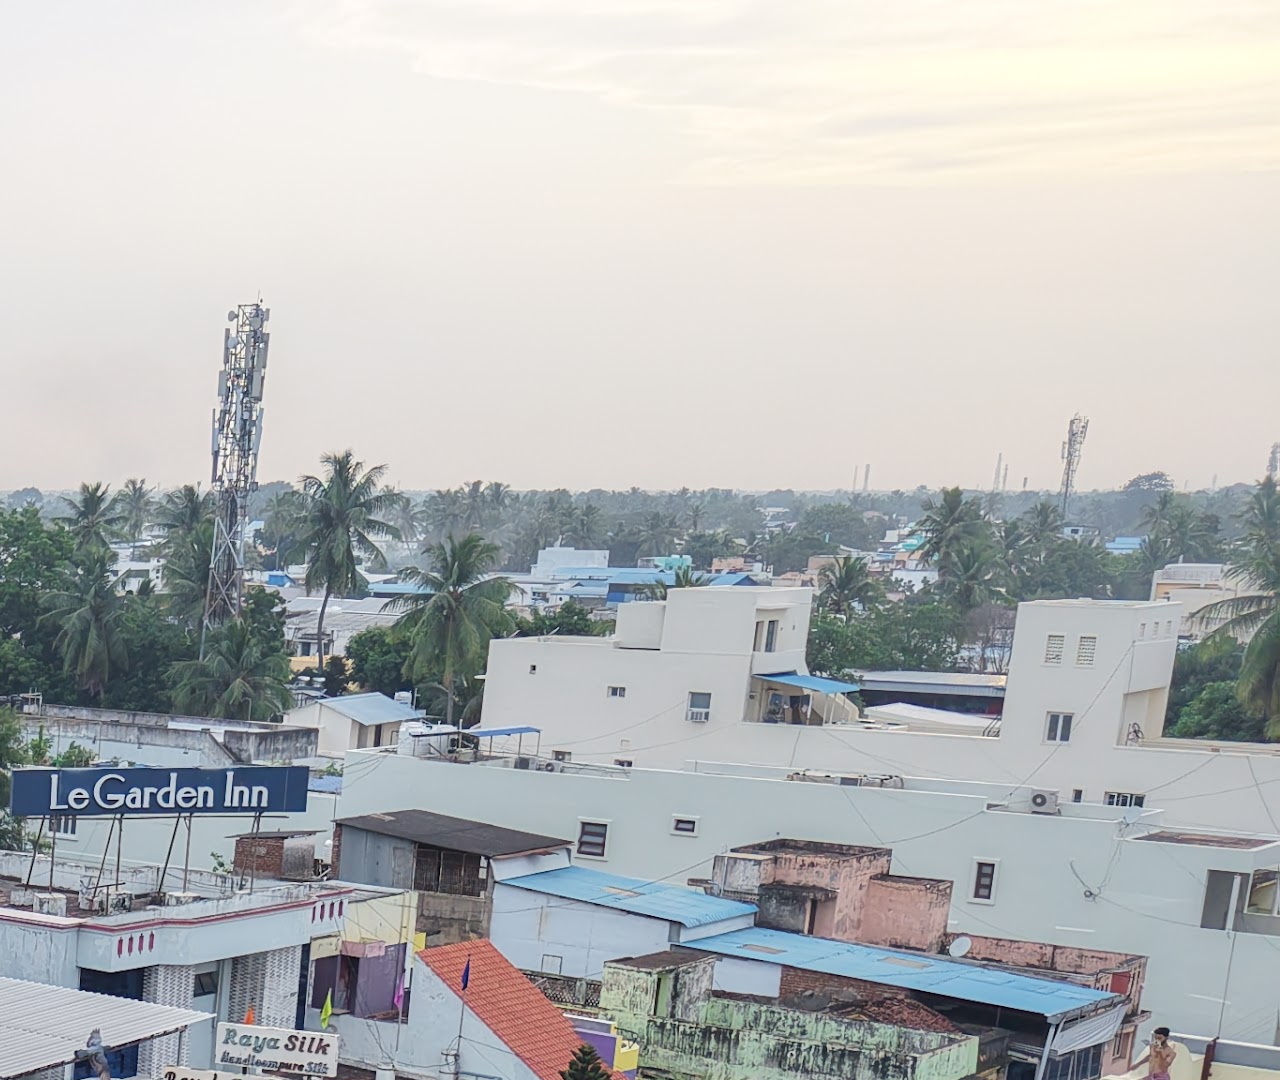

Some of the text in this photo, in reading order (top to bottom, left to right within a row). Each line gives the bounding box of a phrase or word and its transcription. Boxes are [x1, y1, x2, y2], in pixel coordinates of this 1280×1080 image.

[50, 771, 269, 810] Le Garden Inn
[223, 1028, 331, 1056] Raya Silk
